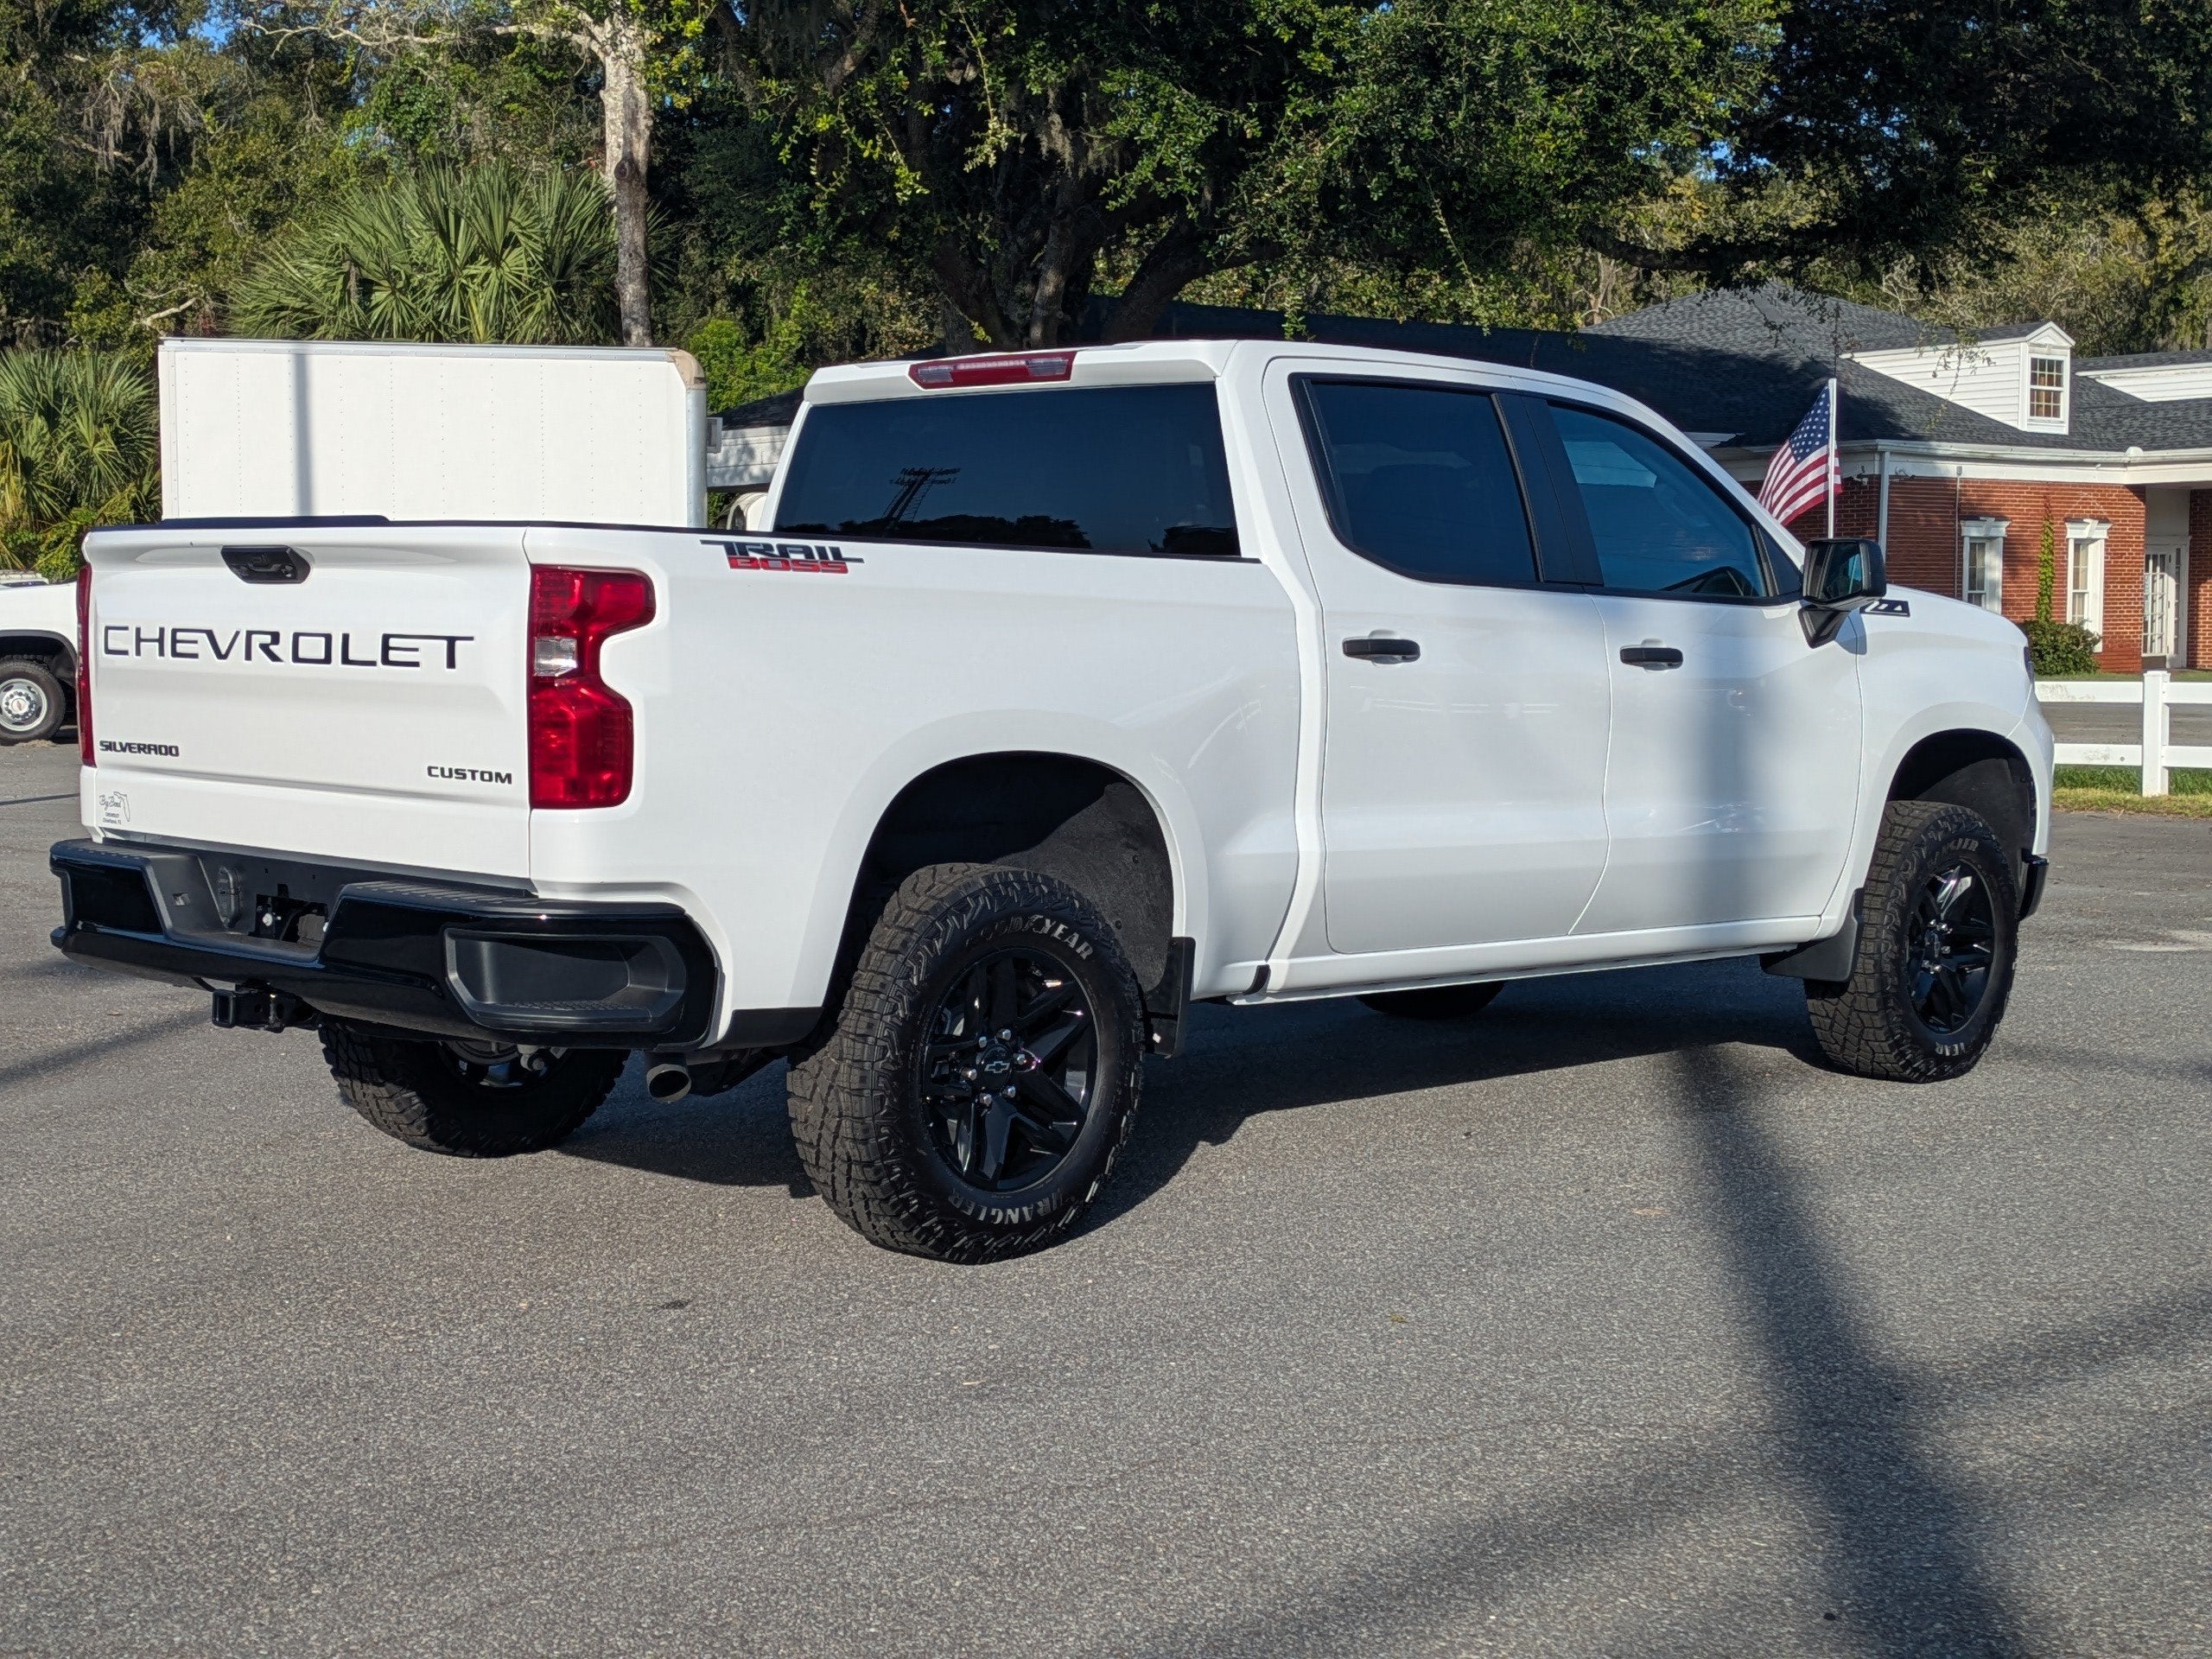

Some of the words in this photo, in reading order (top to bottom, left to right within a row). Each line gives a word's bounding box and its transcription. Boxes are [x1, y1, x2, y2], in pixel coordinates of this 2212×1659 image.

[700, 539, 865, 563] TRAIL
[728, 556, 849, 574] BOSS
[104, 626, 474, 669] CHEVROLET
[99, 741, 180, 757] SILVERADO
[427, 766, 512, 785] CUSTOM
